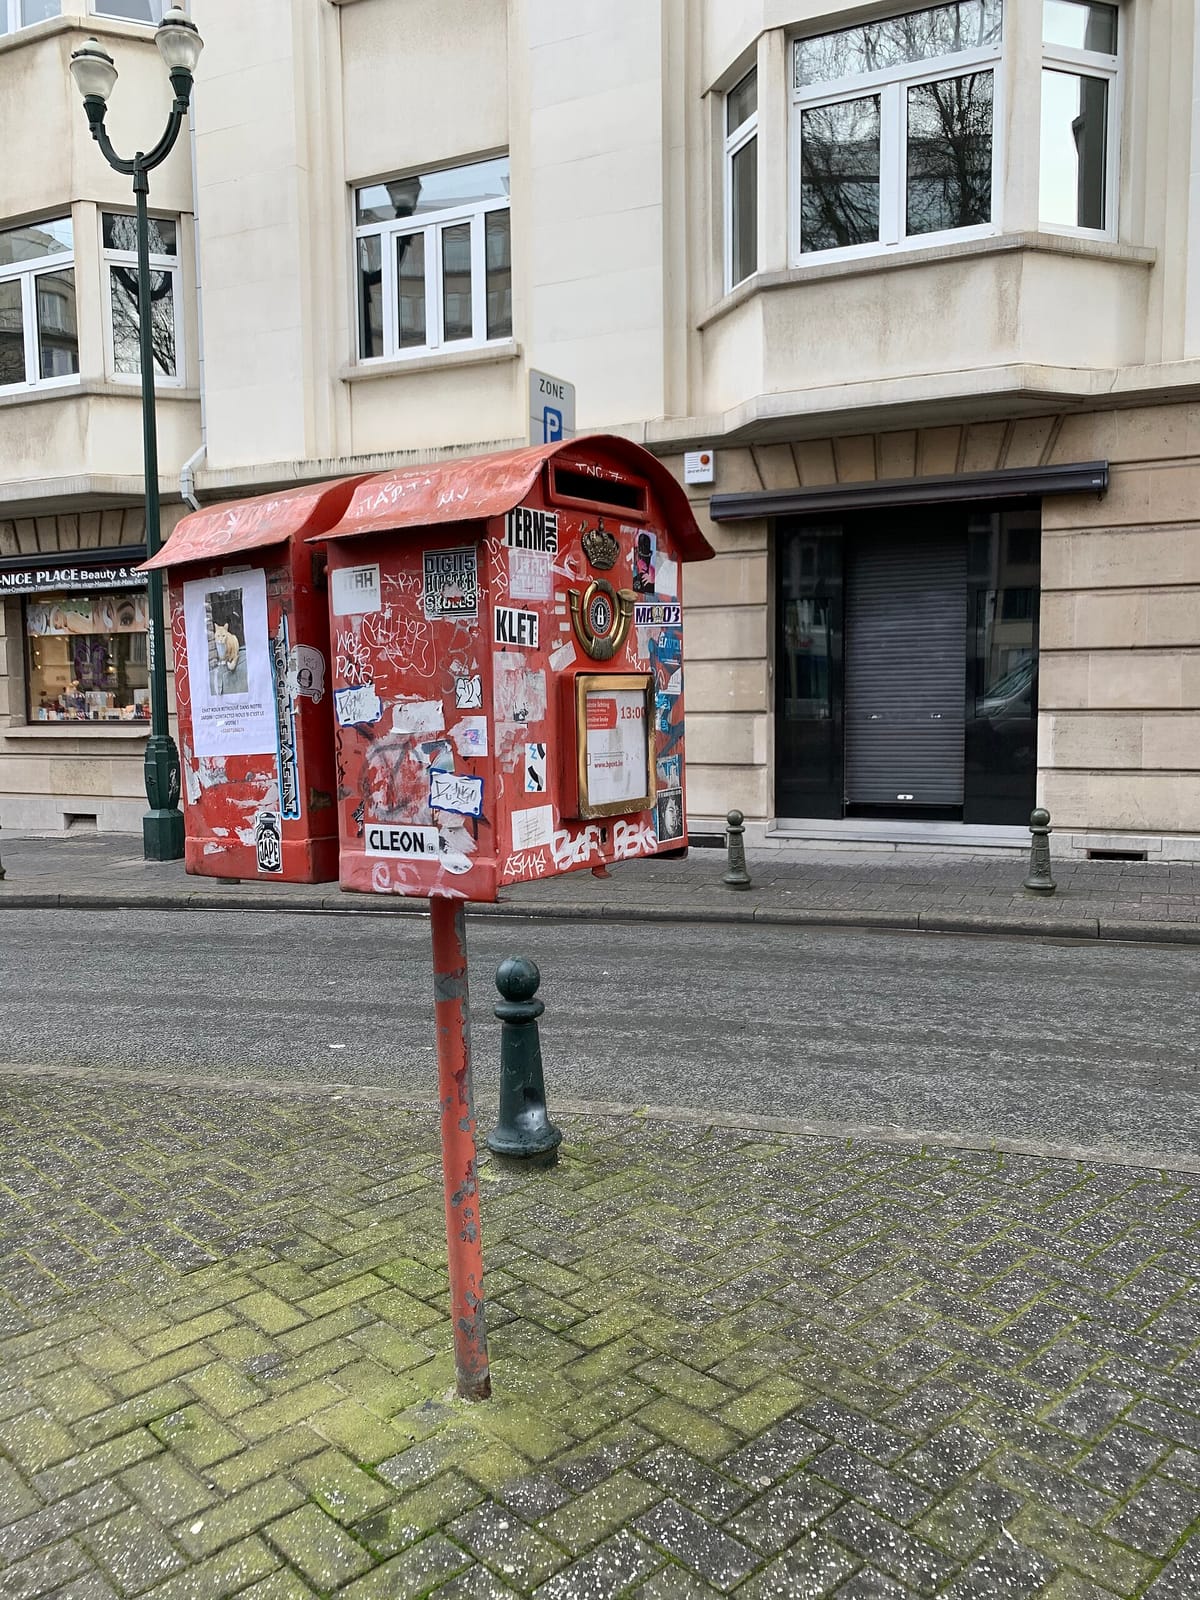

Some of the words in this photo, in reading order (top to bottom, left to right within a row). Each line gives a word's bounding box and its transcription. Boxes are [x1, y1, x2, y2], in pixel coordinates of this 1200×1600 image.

[539, 378, 564, 400] ZONE
[546, 411, 560, 443] P
[36, 568, 79, 583] PLACE
[80, 569, 116, 580] Beauty
[119, 568, 128, 578] &
[496, 608, 537, 646] KLET
[620, 706, 646, 720] 13:00
[370, 830, 424, 852] CLEON
